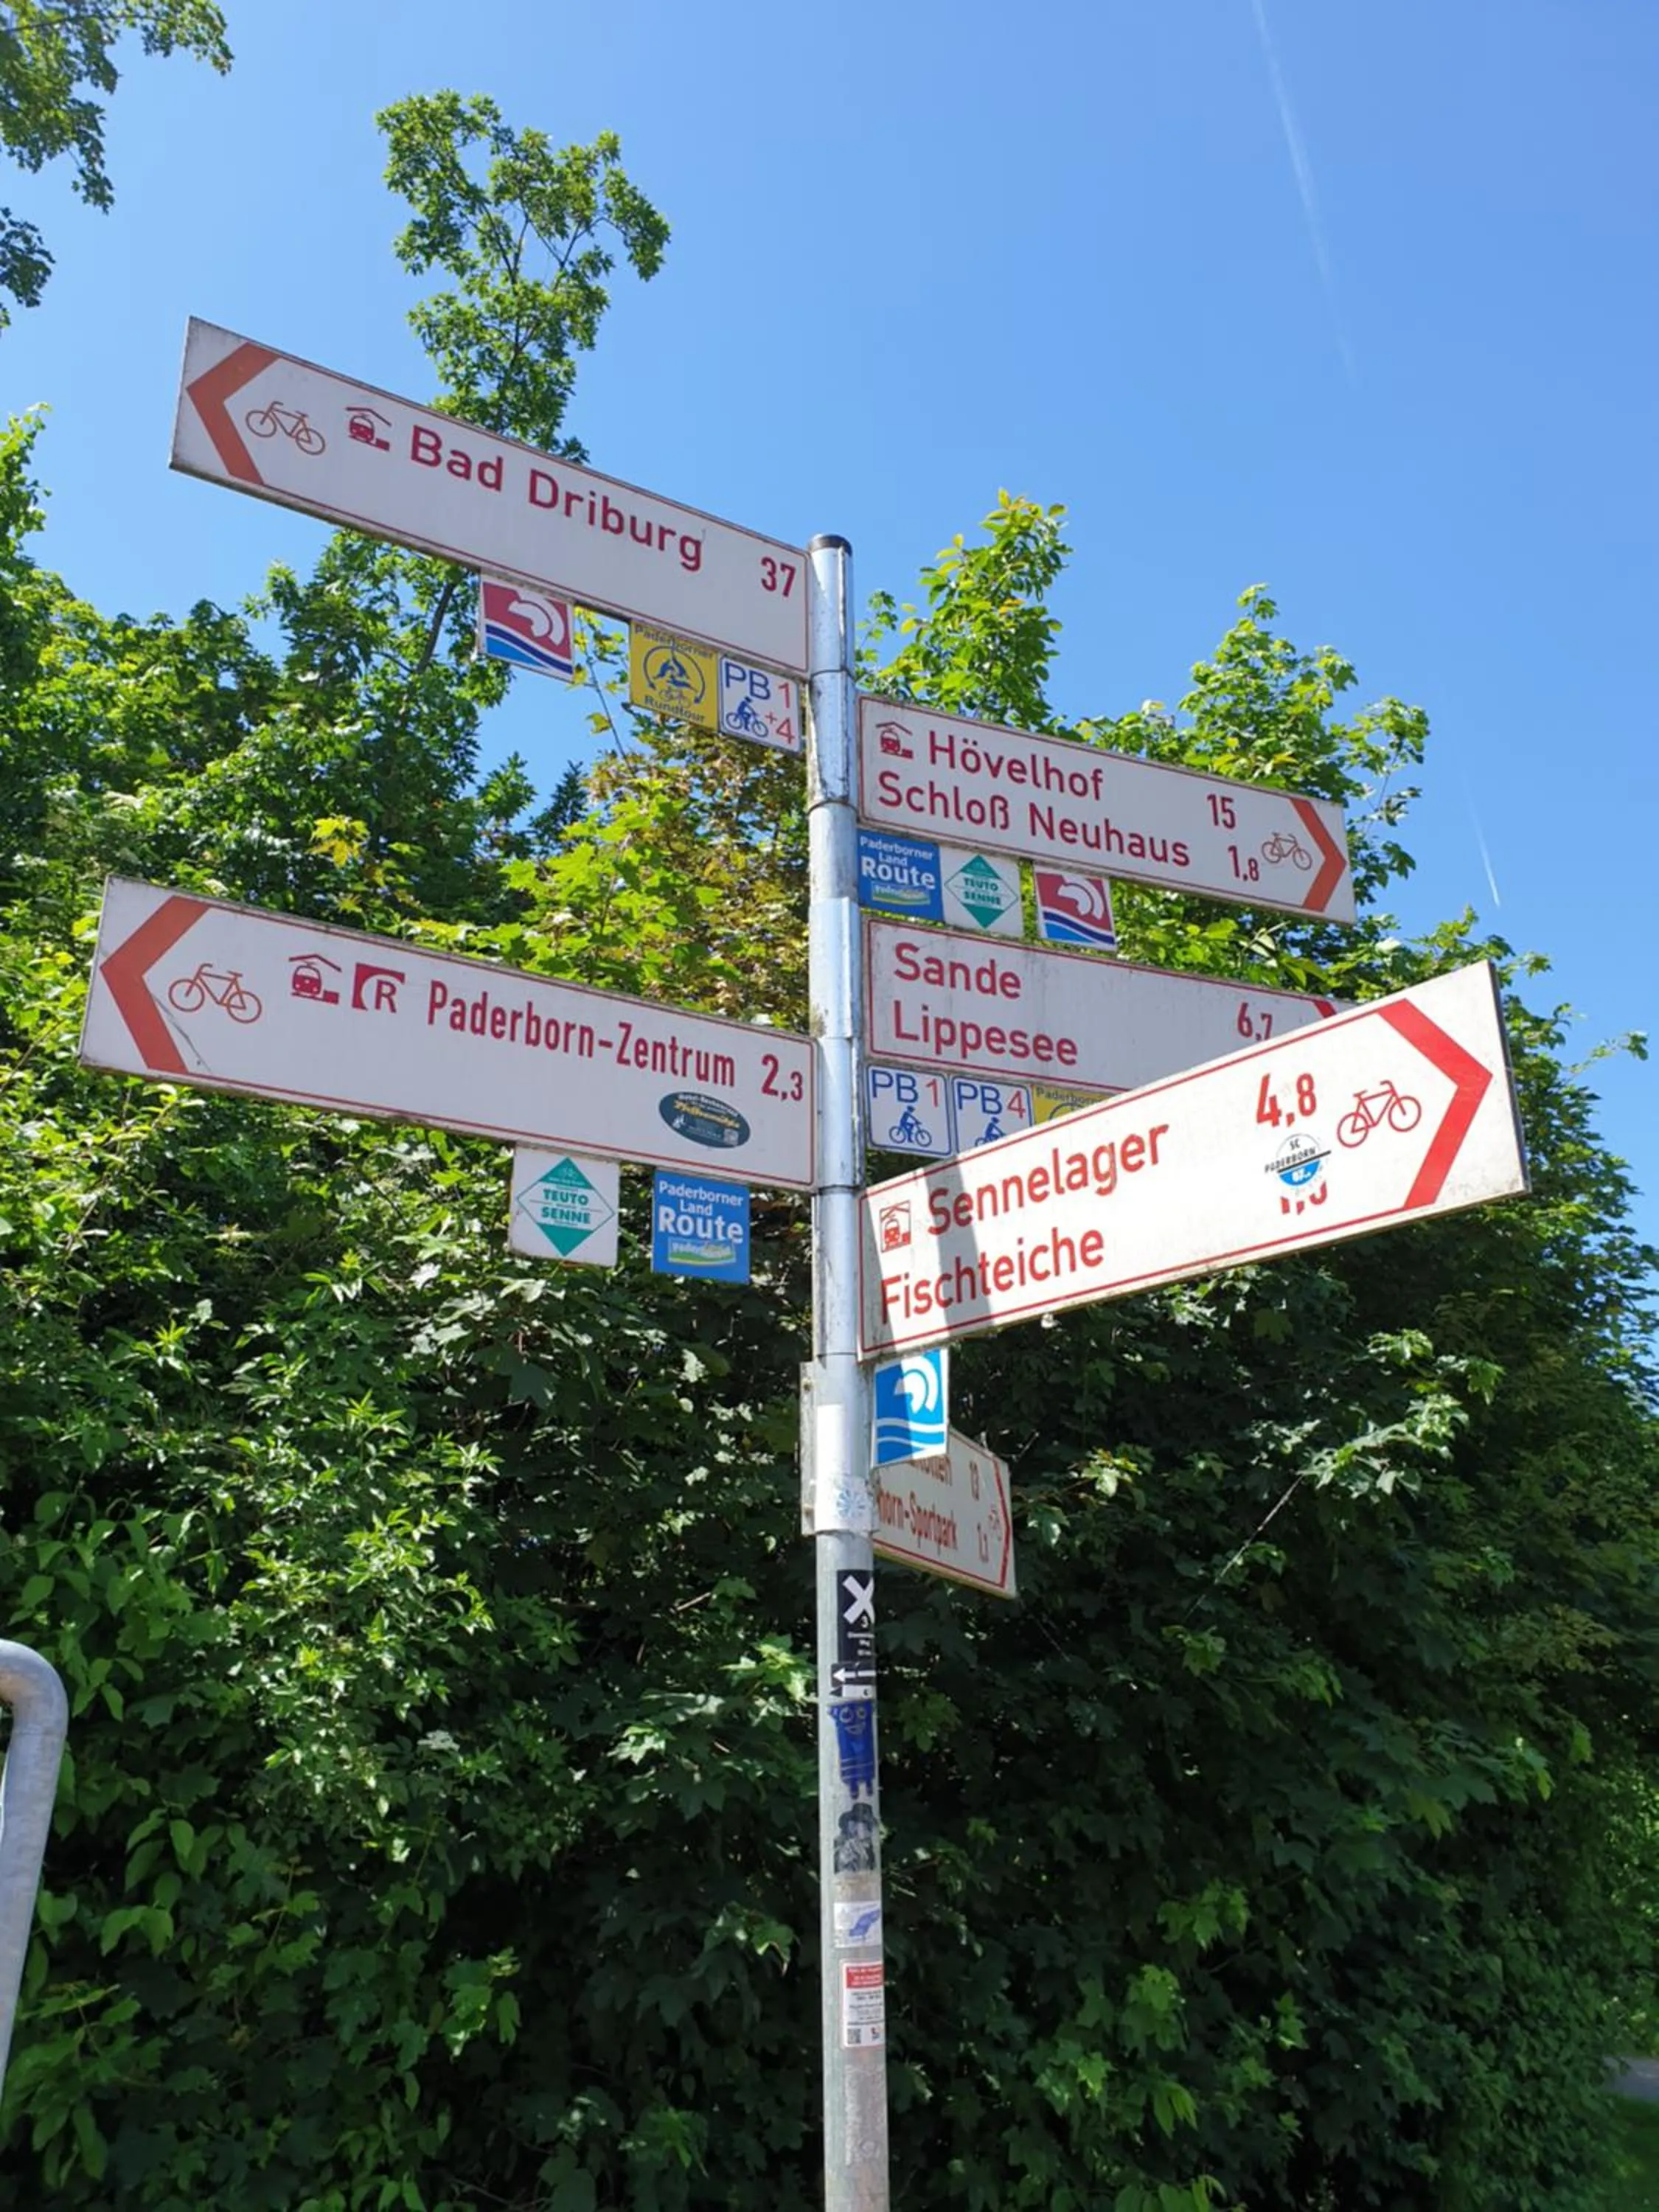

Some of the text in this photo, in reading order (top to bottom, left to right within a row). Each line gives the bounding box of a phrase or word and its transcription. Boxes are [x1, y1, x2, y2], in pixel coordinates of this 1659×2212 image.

[411, 424, 797, 598] Bad Driburg 37
[724, 661, 791, 709] PB 1
[928, 728, 1237, 830] Hövelhof 15
[877, 771, 1010, 830] Schloß
[1028, 801, 1192, 868] Neuhaus
[859, 835, 934, 861] Paderborner
[878, 851, 908, 866] Land
[860, 855, 936, 890] Route
[964, 876, 999, 891] TEUTO
[964, 890, 1002, 905] SENNE
[894, 941, 1023, 1001] Sande
[428, 979, 735, 1088] Paderborn-Zentrum
[761, 1053, 804, 1101] 2,3
[893, 1001, 1078, 1067] Lippesee
[871, 1068, 939, 1108] PB 1
[956, 1081, 1027, 1119] PB 4
[927, 1071, 1318, 1237] Sennelager 4,8
[1264, 1147, 1317, 1174] PADERBORN
[543, 1189, 590, 1206] TEUTO
[658, 1180, 744, 1206] Paderborner
[680, 1198, 714, 1216] Land
[540, 1206, 591, 1225] SENNE
[658, 1205, 744, 1245] Route
[880, 1225, 1106, 1325] Fischteiche
